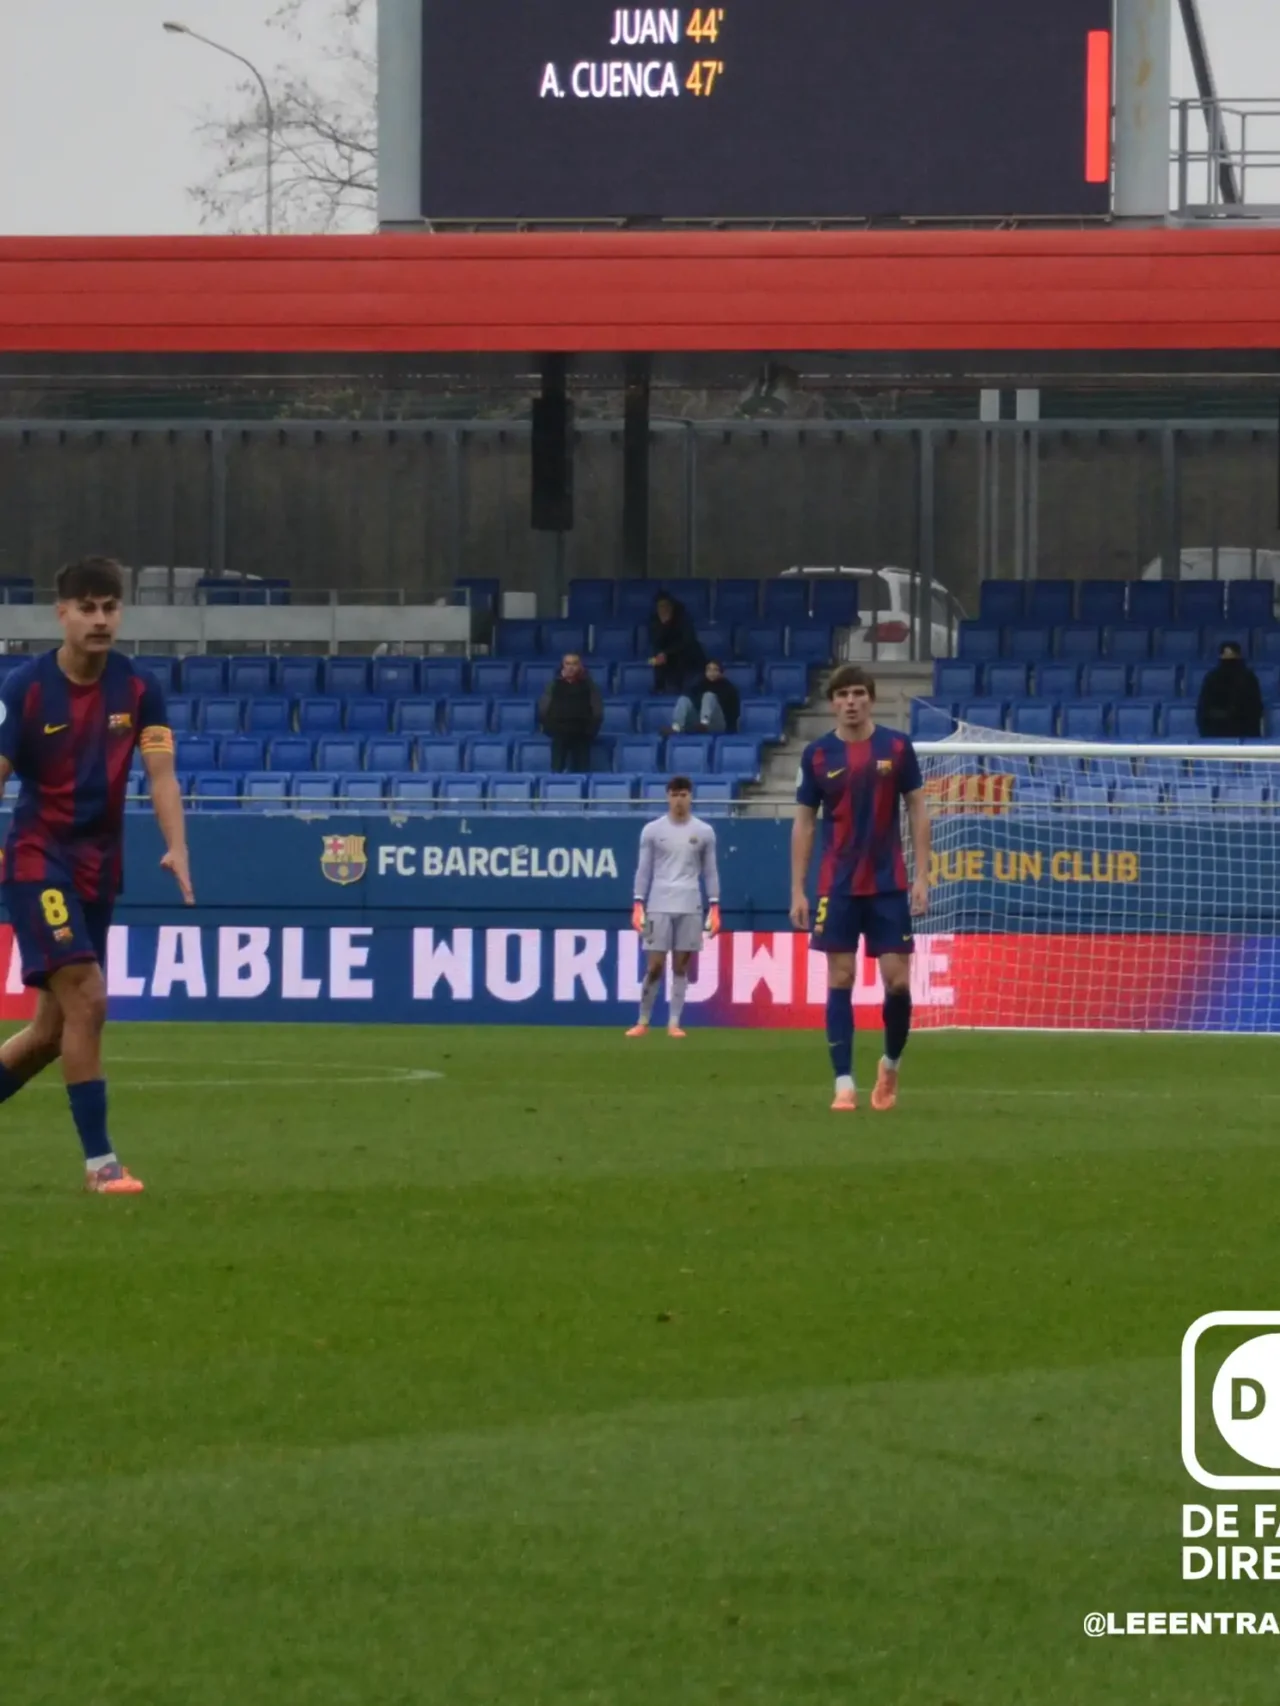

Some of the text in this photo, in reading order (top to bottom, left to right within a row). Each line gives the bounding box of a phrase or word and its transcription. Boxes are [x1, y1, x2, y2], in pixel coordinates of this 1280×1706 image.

[609, 8, 725, 45] JUAN 44'
[539, 61, 725, 98] A. CUENCA 47'
[378, 846, 618, 879] FC BARCELONA
[928, 851, 1140, 888] QUE UN CLUB
[41, 888, 69, 926] 8
